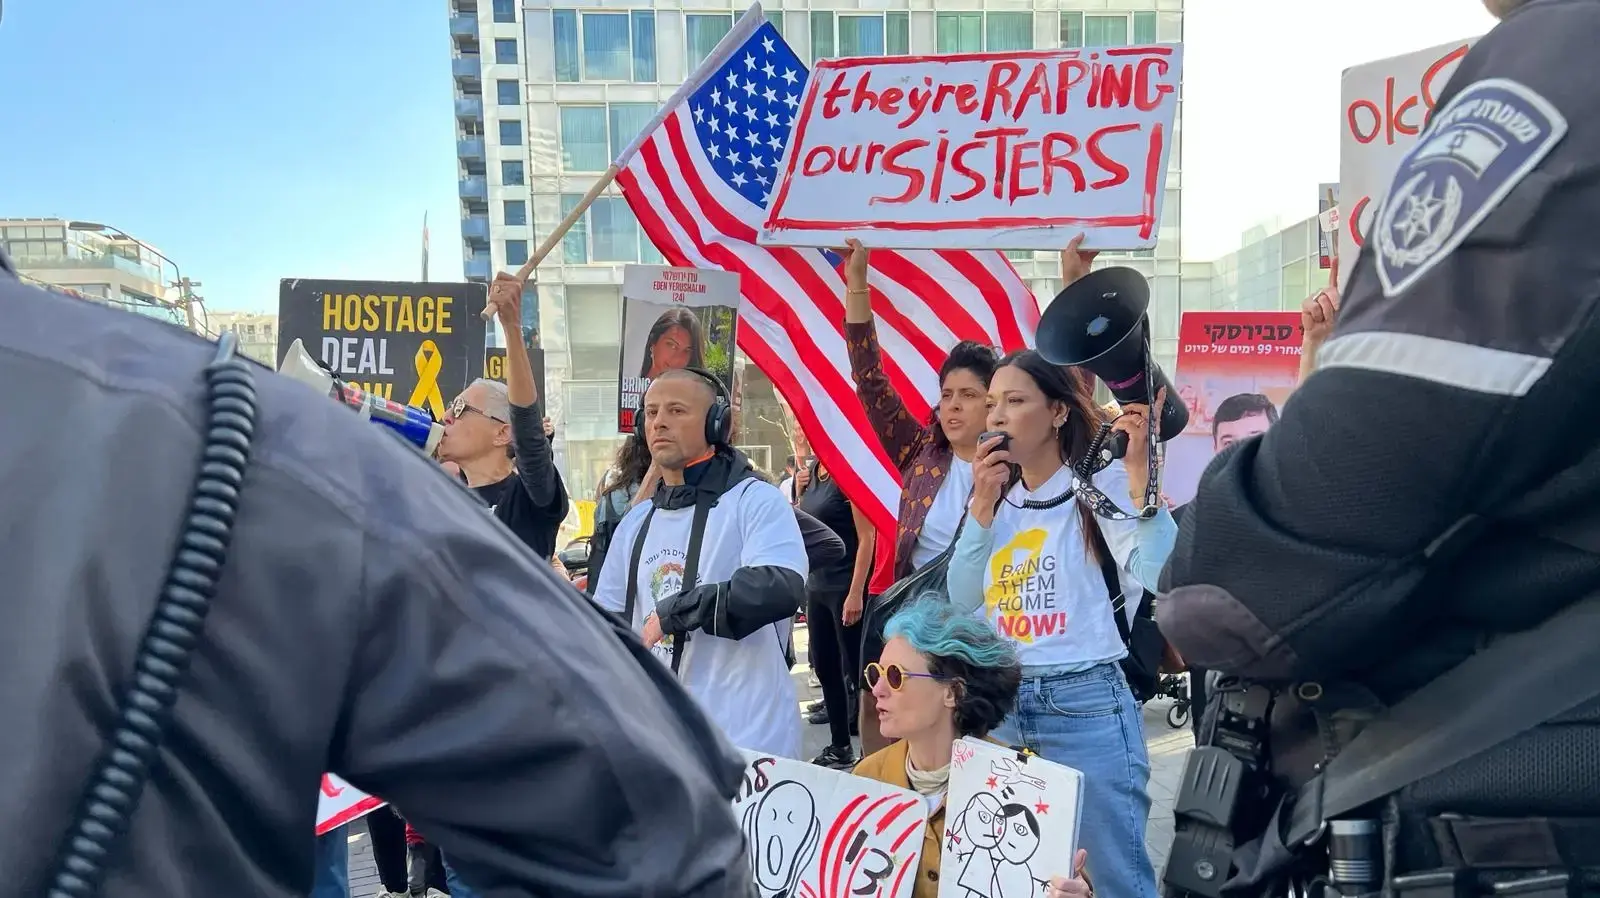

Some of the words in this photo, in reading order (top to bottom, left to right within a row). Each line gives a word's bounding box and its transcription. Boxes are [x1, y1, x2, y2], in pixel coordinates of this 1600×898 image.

[803, 141, 885, 177] our
[653, 281, 668, 291] EDEN
[668, 282, 706, 294] YERUSHALMI
[322, 294, 453, 334] HOSTAGE
[1203, 324, 1293, 343] סבירסקי
[321, 337, 394, 375] DEAL
[1185, 344, 1208, 353] סיוט
[1211, 343, 1227, 354] של
[1230, 345, 1254, 354] ימים
[1257, 344, 1271, 355] 99
[1275, 346, 1302, 355] אחרי
[621, 392, 640, 409] HER
[621, 411, 634, 426] HO
[1000, 555, 1056, 579] BRING
[998, 574, 1055, 595] THEM
[998, 593, 1055, 611] HOME
[997, 612, 1066, 637] NOW!
